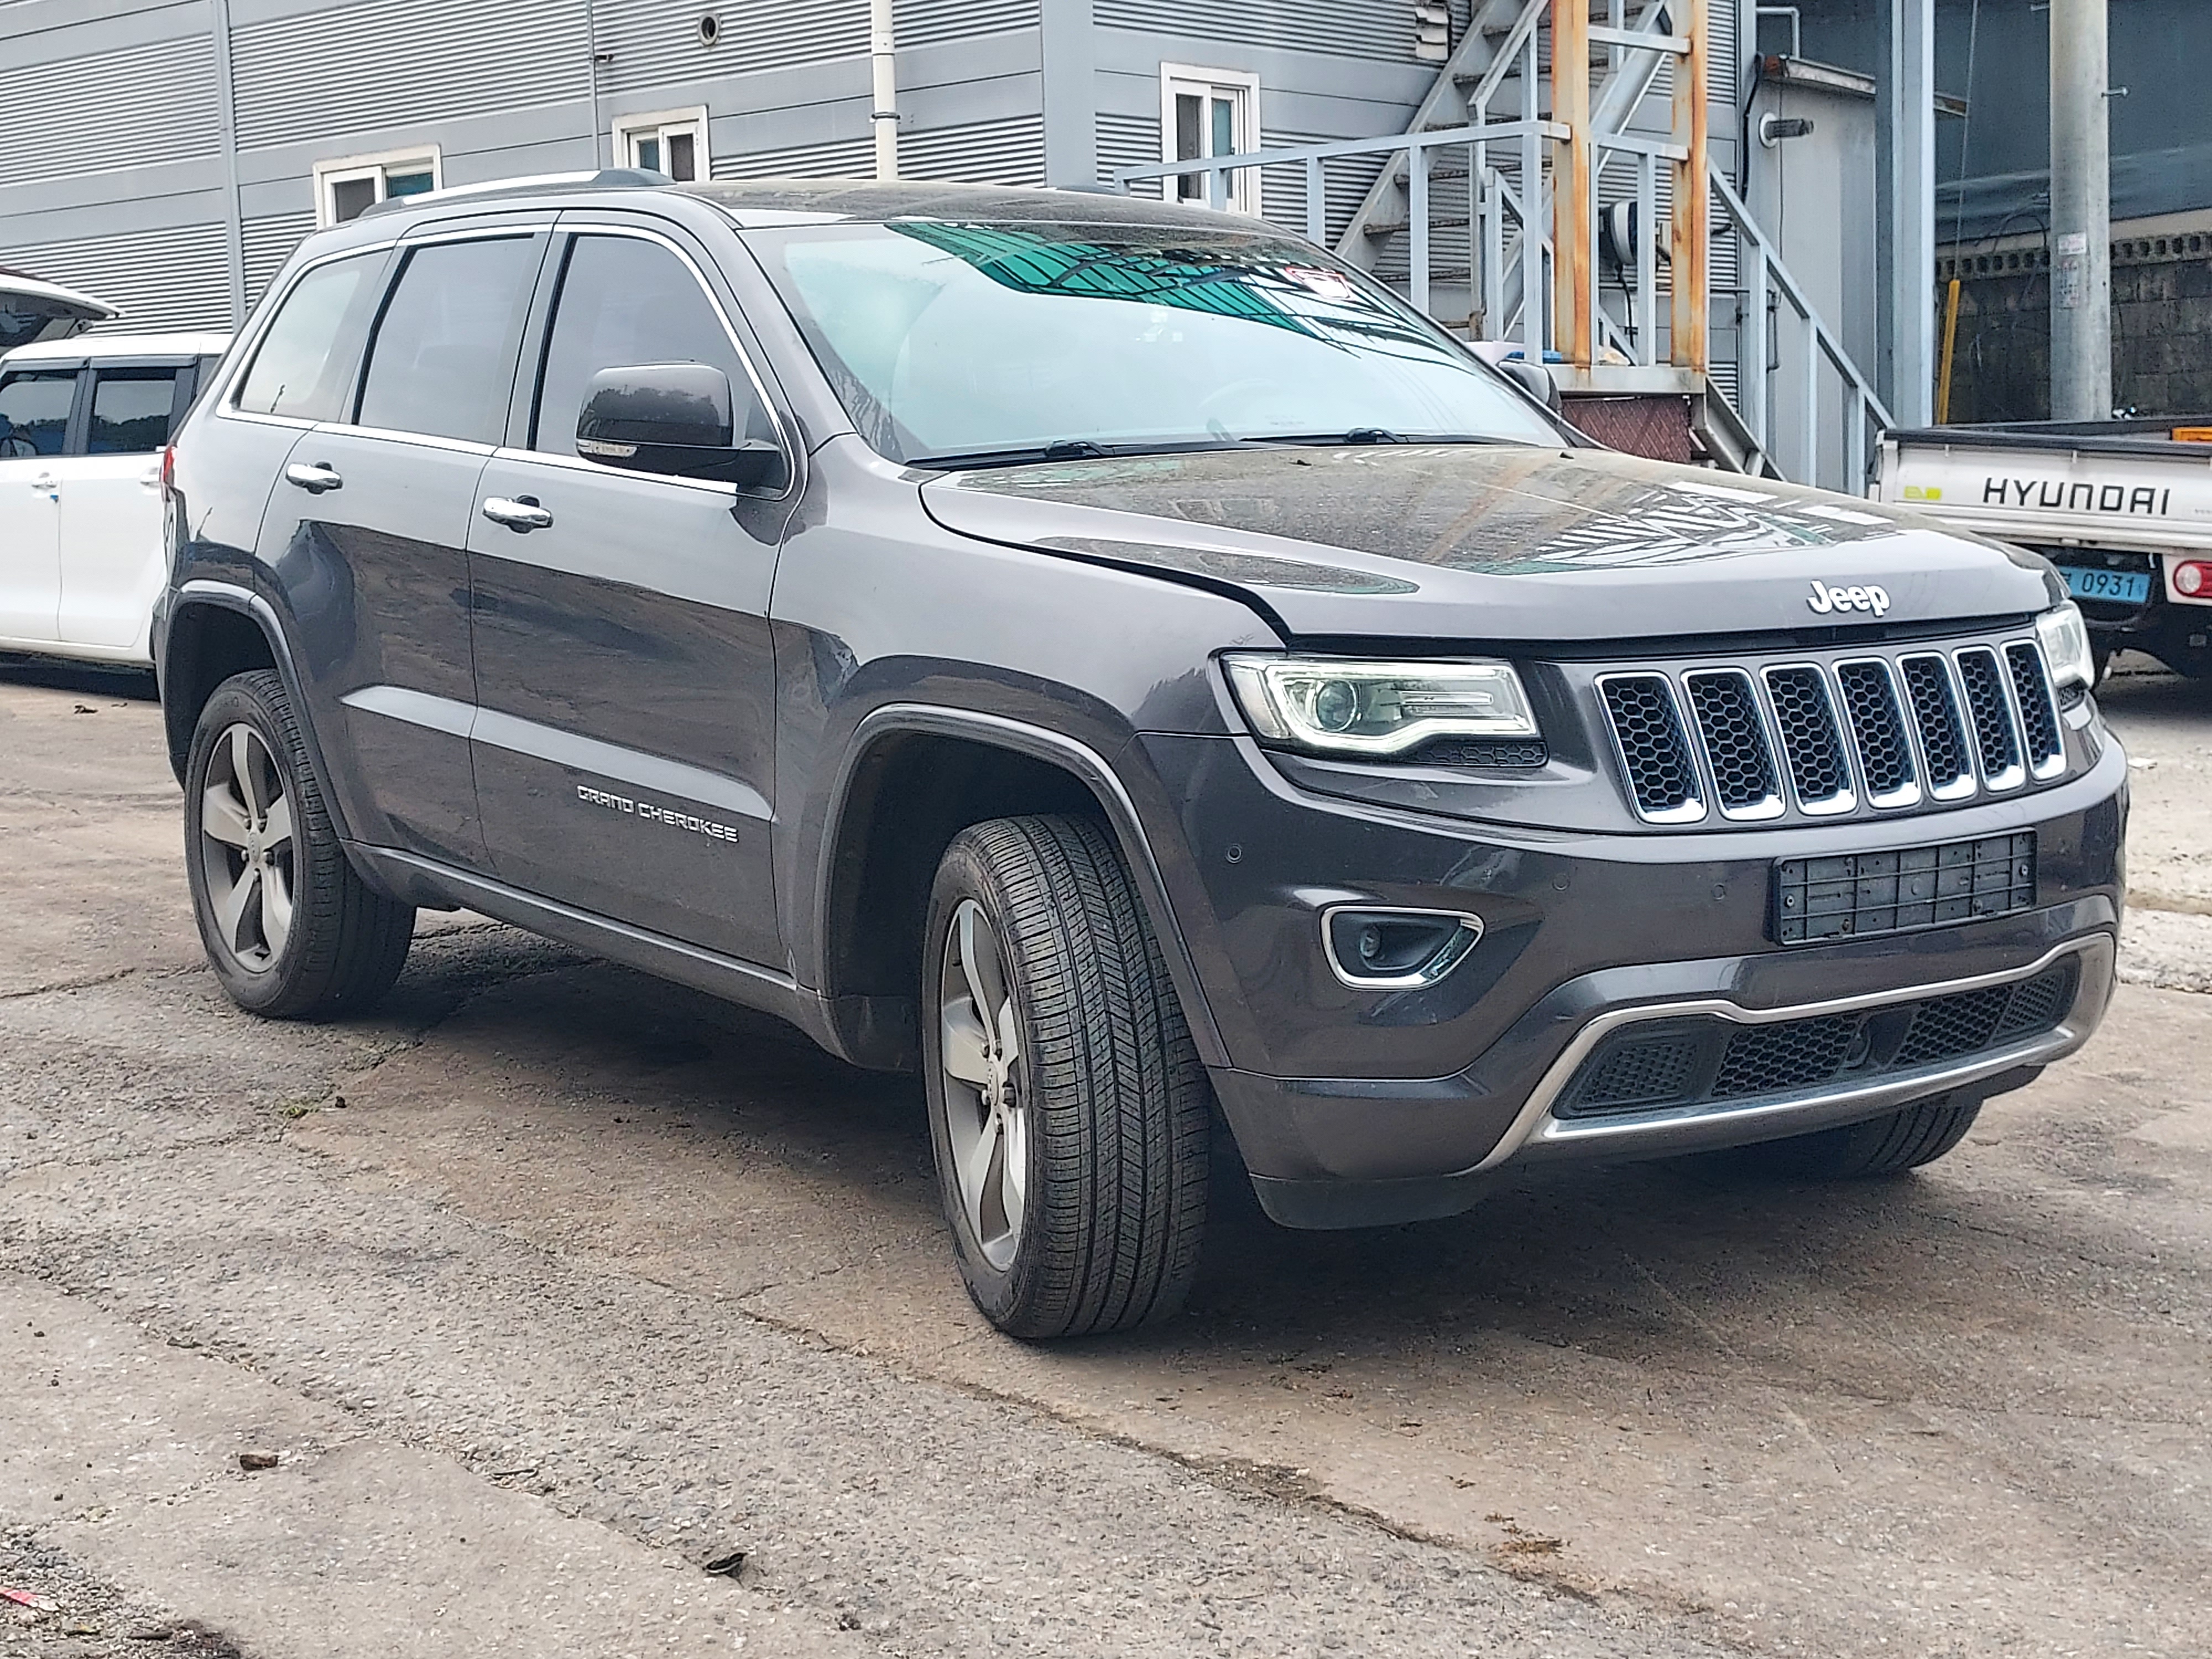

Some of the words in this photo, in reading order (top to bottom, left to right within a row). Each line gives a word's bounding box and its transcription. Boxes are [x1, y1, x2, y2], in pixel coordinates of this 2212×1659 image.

[1983, 477, 2170, 515] HYUNDAI
[1806, 579, 1891, 618] Jeep
[2081, 572, 2135, 598] 0931
[577, 785, 635, 813] GRAND
[637, 802, 739, 843] CHEROKEE
